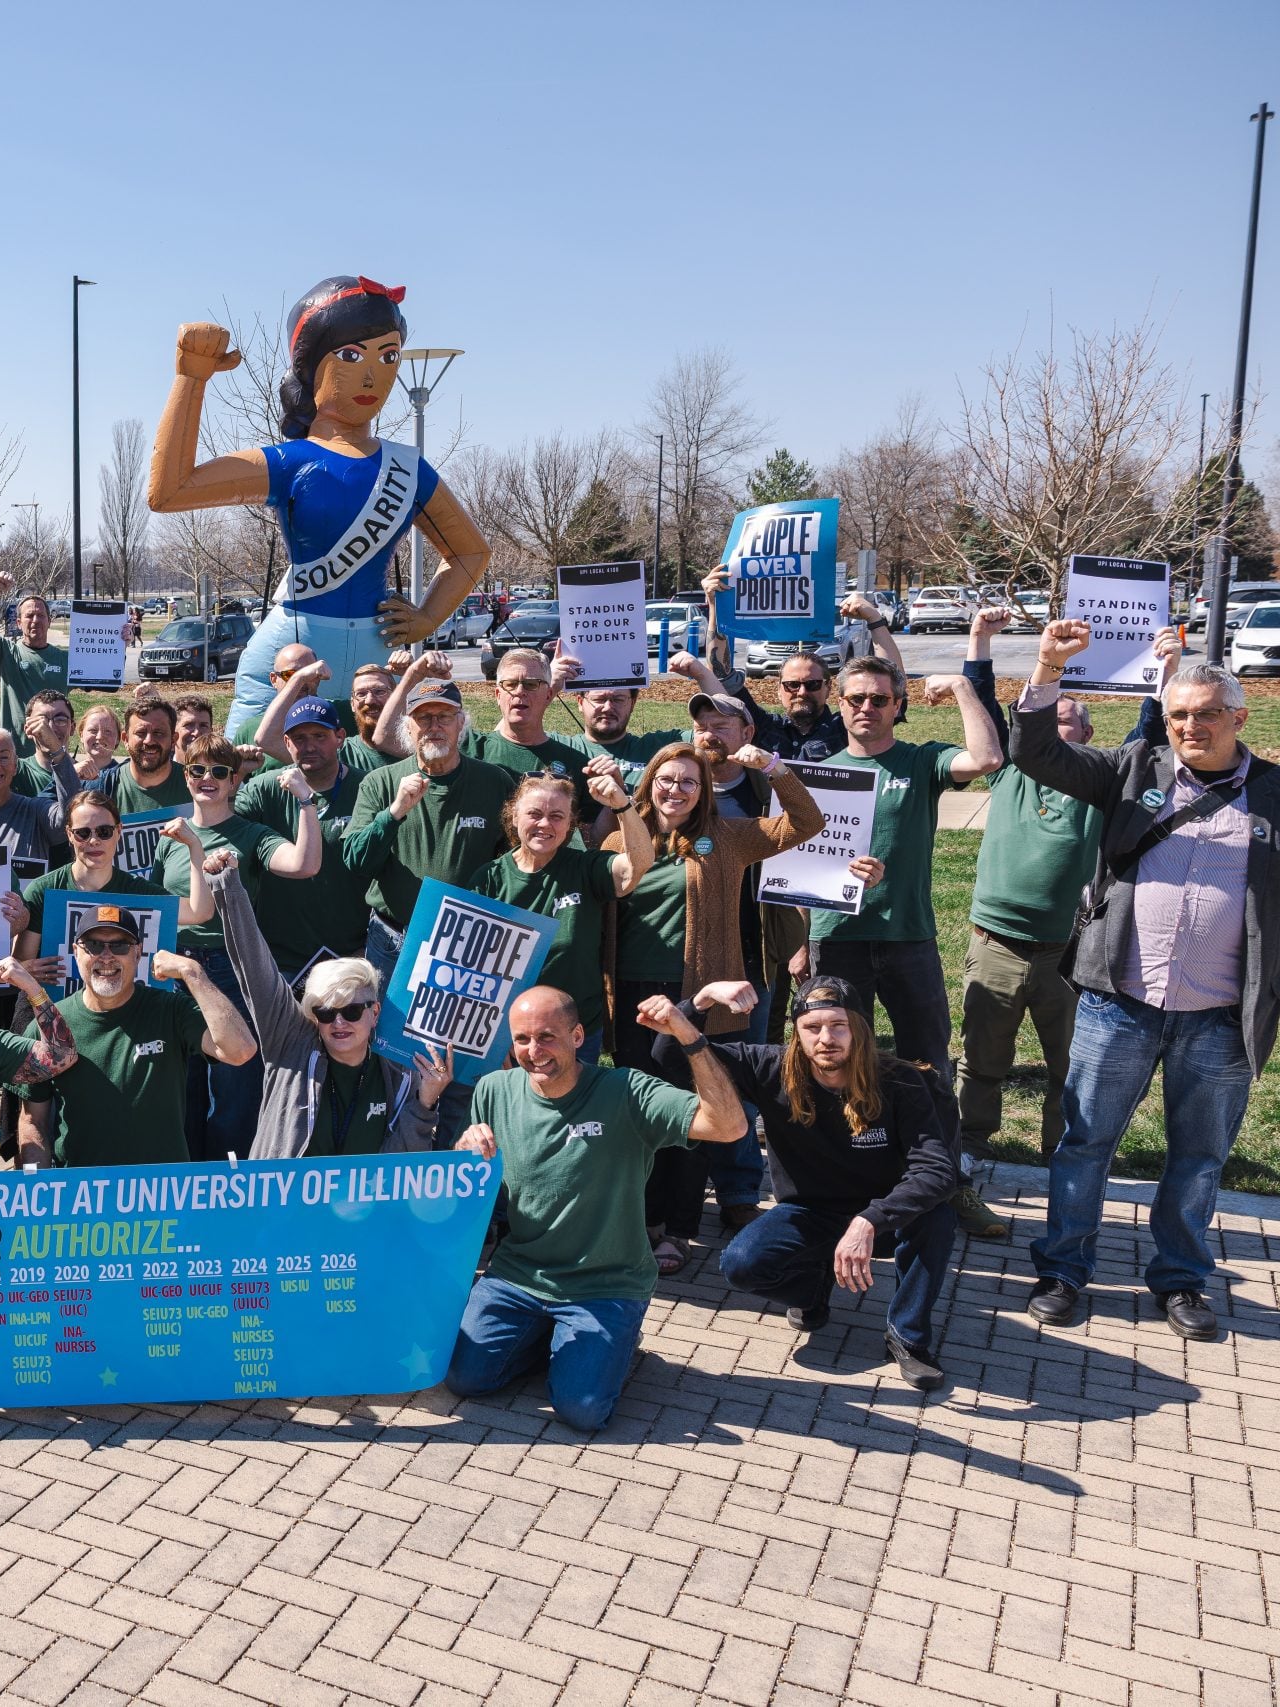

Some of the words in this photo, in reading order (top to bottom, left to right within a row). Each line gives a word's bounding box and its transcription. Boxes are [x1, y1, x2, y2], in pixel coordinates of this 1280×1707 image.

[295, 457, 410, 593] SOLIDARITY
[746, 557, 796, 576] OVER
[1128, 562, 1143, 570] 4100
[736, 576, 809, 611] PROFITS
[569, 604, 635, 615] STANDING
[1078, 599, 1157, 611] STANDING
[575, 621, 598, 629] FOR
[604, 618, 630, 627] OUR
[1084, 615, 1113, 624] FOR
[1120, 616, 1150, 625] OUR
[571, 632, 635, 643] STUDENTS
[1090, 631, 1155, 641] UDENTS
[292, 704, 327, 718] CHICAGO
[821, 829, 851, 841] OUR
[797, 843, 856, 858] UDENTS
[430, 909, 531, 981] PEOPLE
[434, 965, 496, 1000] OVER
[407, 981, 500, 1048] PROFITS
[73, 1180, 110, 1214] AT
[117, 1171, 296, 1213] UNIVERSITY
[302, 1169, 342, 1205] OF
[348, 1162, 492, 1202] ILLINOIS?
[10, 1218, 201, 1260] AUTHORIZE...
[10, 1267, 45, 1283] 2019
[54, 1265, 90, 1281] 2020
[99, 1263, 133, 1279] 2021
[142, 1262, 178, 1277] 2022
[187, 1260, 222, 1276] 2023
[231, 1258, 268, 1274] 2024
[276, 1256, 311, 1272] 2025
[321, 1254, 357, 1270] 2026
[141, 1285, 182, 1298] UIC-GEO
[189, 1284, 222, 1296] UICUF
[230, 1282, 270, 1294] SEIU73
[53, 1289, 92, 1301] SEIU73
[59, 1304, 88, 1317] (UIC)
[233, 1297, 270, 1311] (UIUC)
[142, 1307, 182, 1321] SEIU73
[63, 1326, 86, 1338] INA-
[145, 1322, 182, 1336] (UIUC)
[15, 1334, 47, 1347] UICUF
[55, 1341, 96, 1353] NURSES
[234, 1380, 276, 1393] INA-LPN
